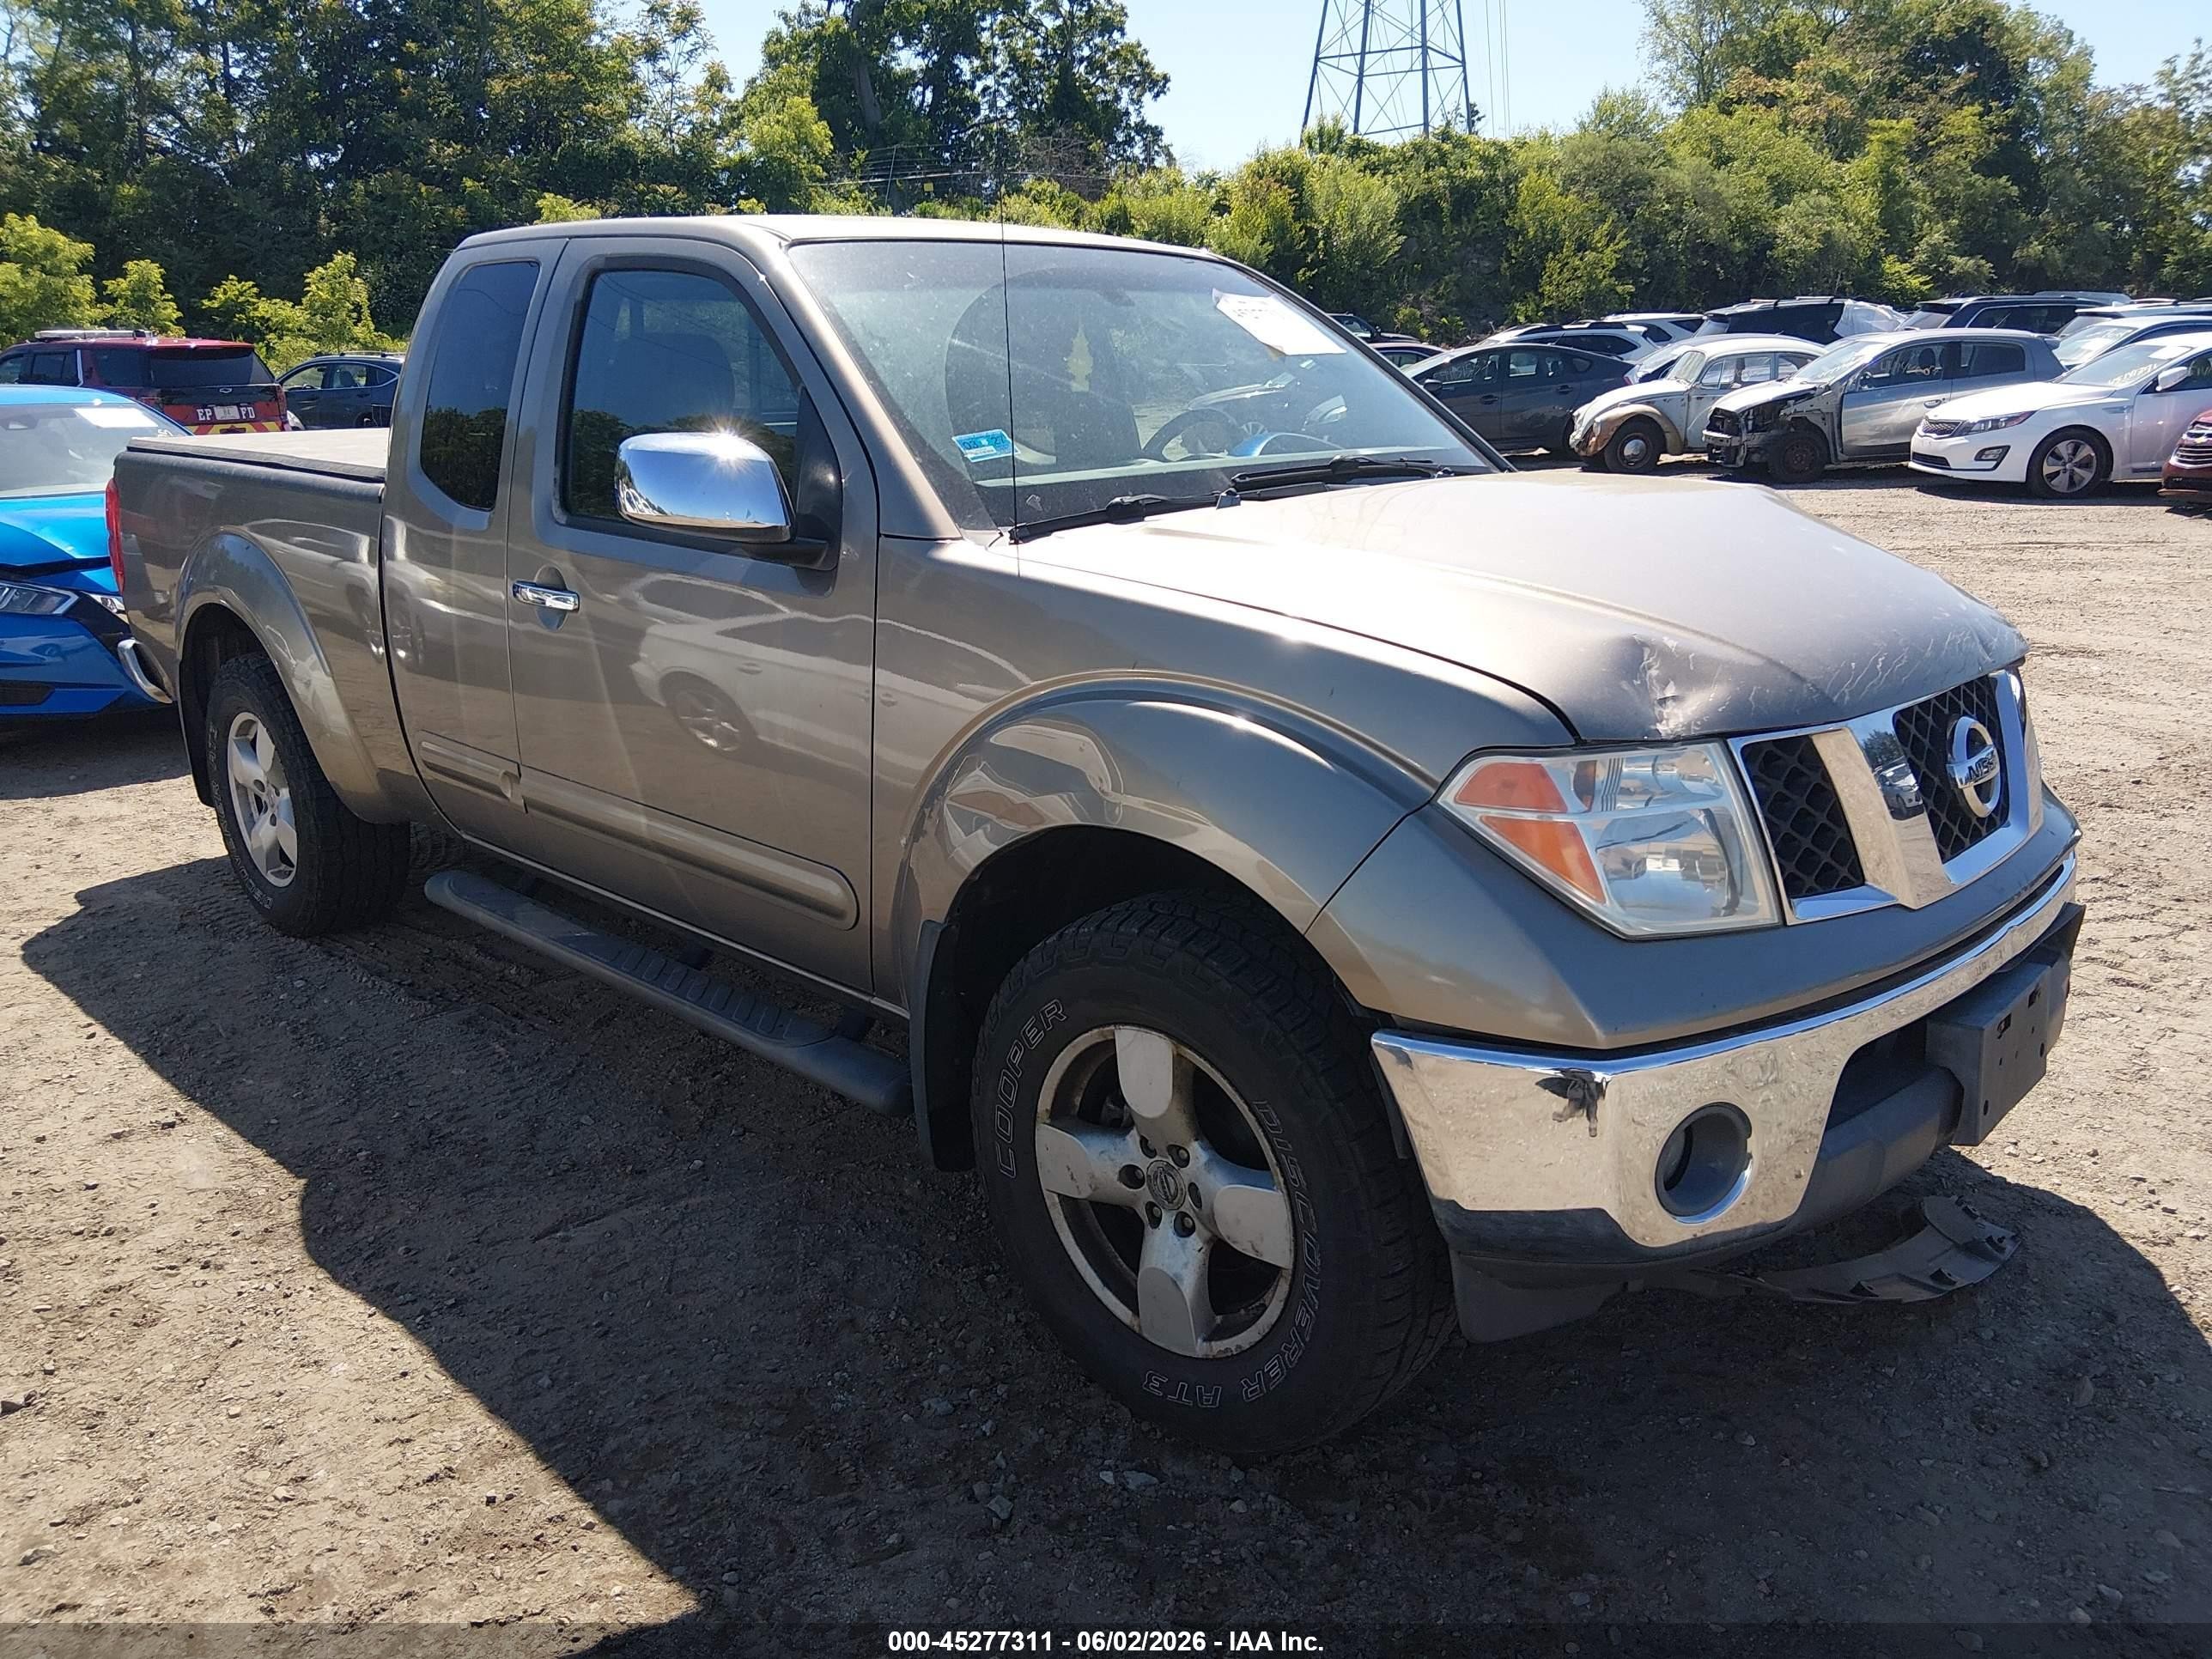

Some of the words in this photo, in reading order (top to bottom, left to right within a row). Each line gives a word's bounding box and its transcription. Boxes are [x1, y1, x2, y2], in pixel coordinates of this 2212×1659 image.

[196, 408, 212, 421] EP
[240, 406, 256, 419] FD
[995, 999, 1067, 1179] COOPER
[1241, 1099, 1322, 1403] DISCOVERER
[1142, 1370, 1223, 1409] AT3
